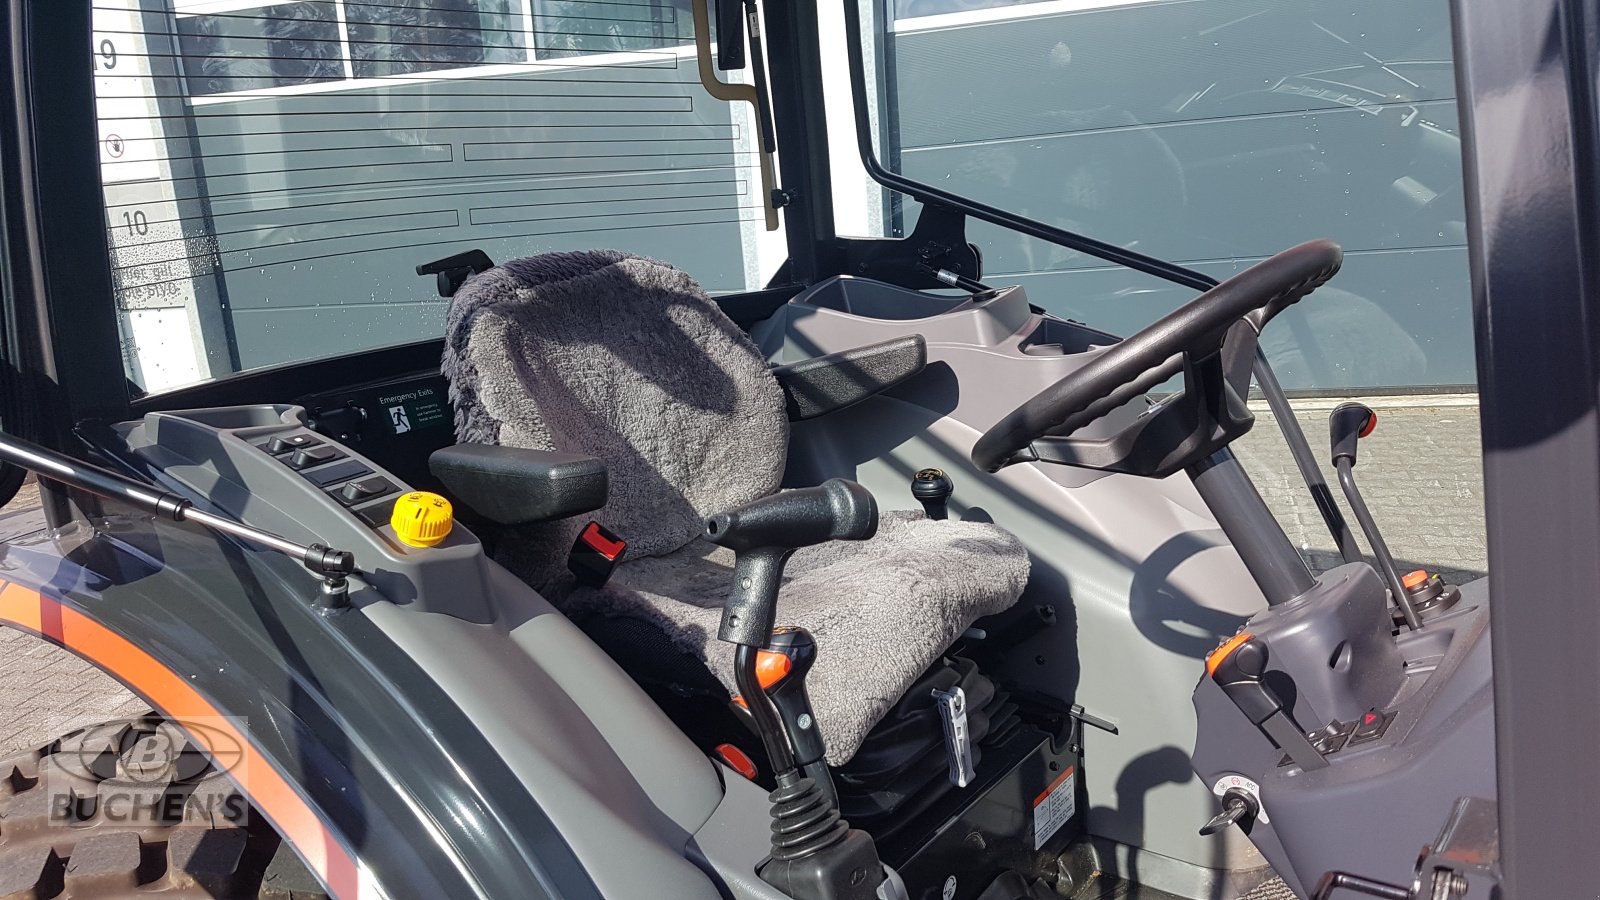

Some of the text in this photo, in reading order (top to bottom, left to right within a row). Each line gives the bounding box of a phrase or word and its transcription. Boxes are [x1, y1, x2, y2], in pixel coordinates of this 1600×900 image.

[123, 210, 148, 236] 10
[380, 389, 434, 404] Emergency Exits
